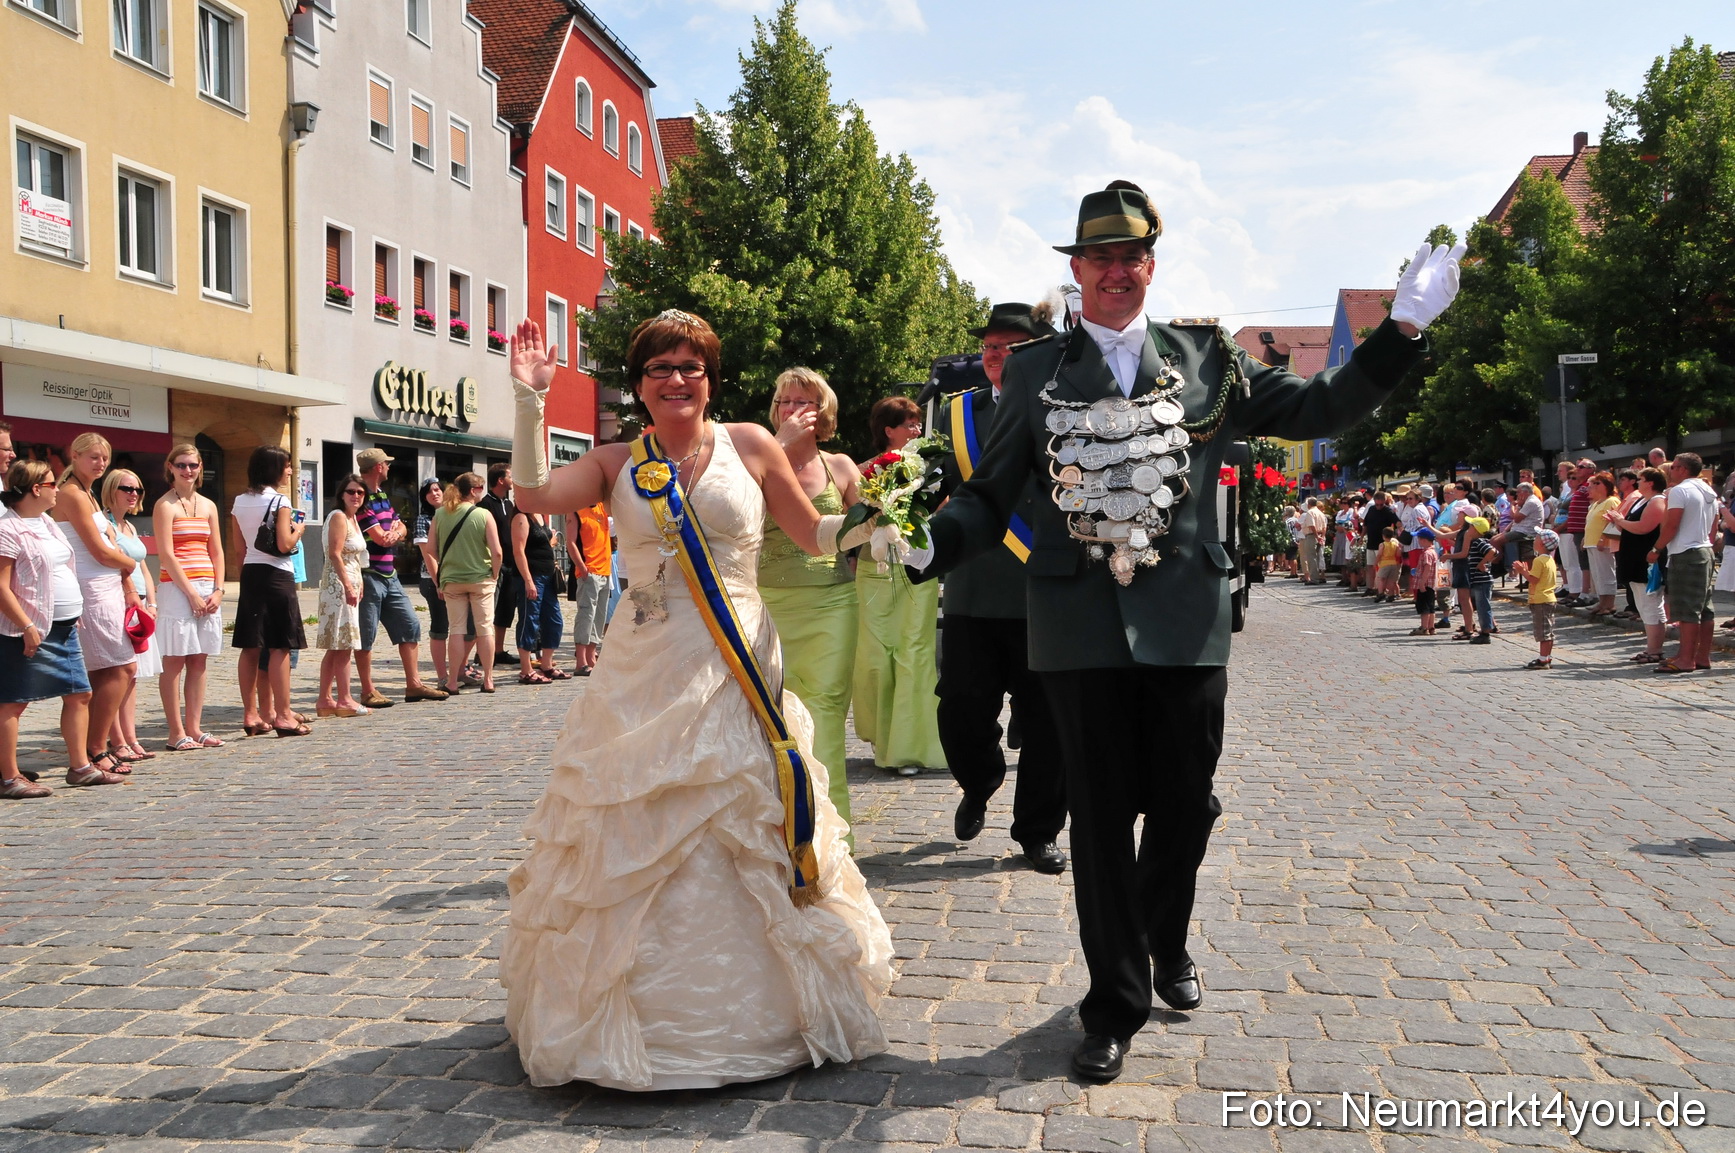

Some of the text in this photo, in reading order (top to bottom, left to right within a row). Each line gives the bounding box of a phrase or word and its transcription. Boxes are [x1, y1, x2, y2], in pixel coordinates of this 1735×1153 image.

[43, 381, 113, 400] Reissinger Optik
[377, 360, 457, 418] Eilles
[91, 404, 130, 418] CENTRUM
